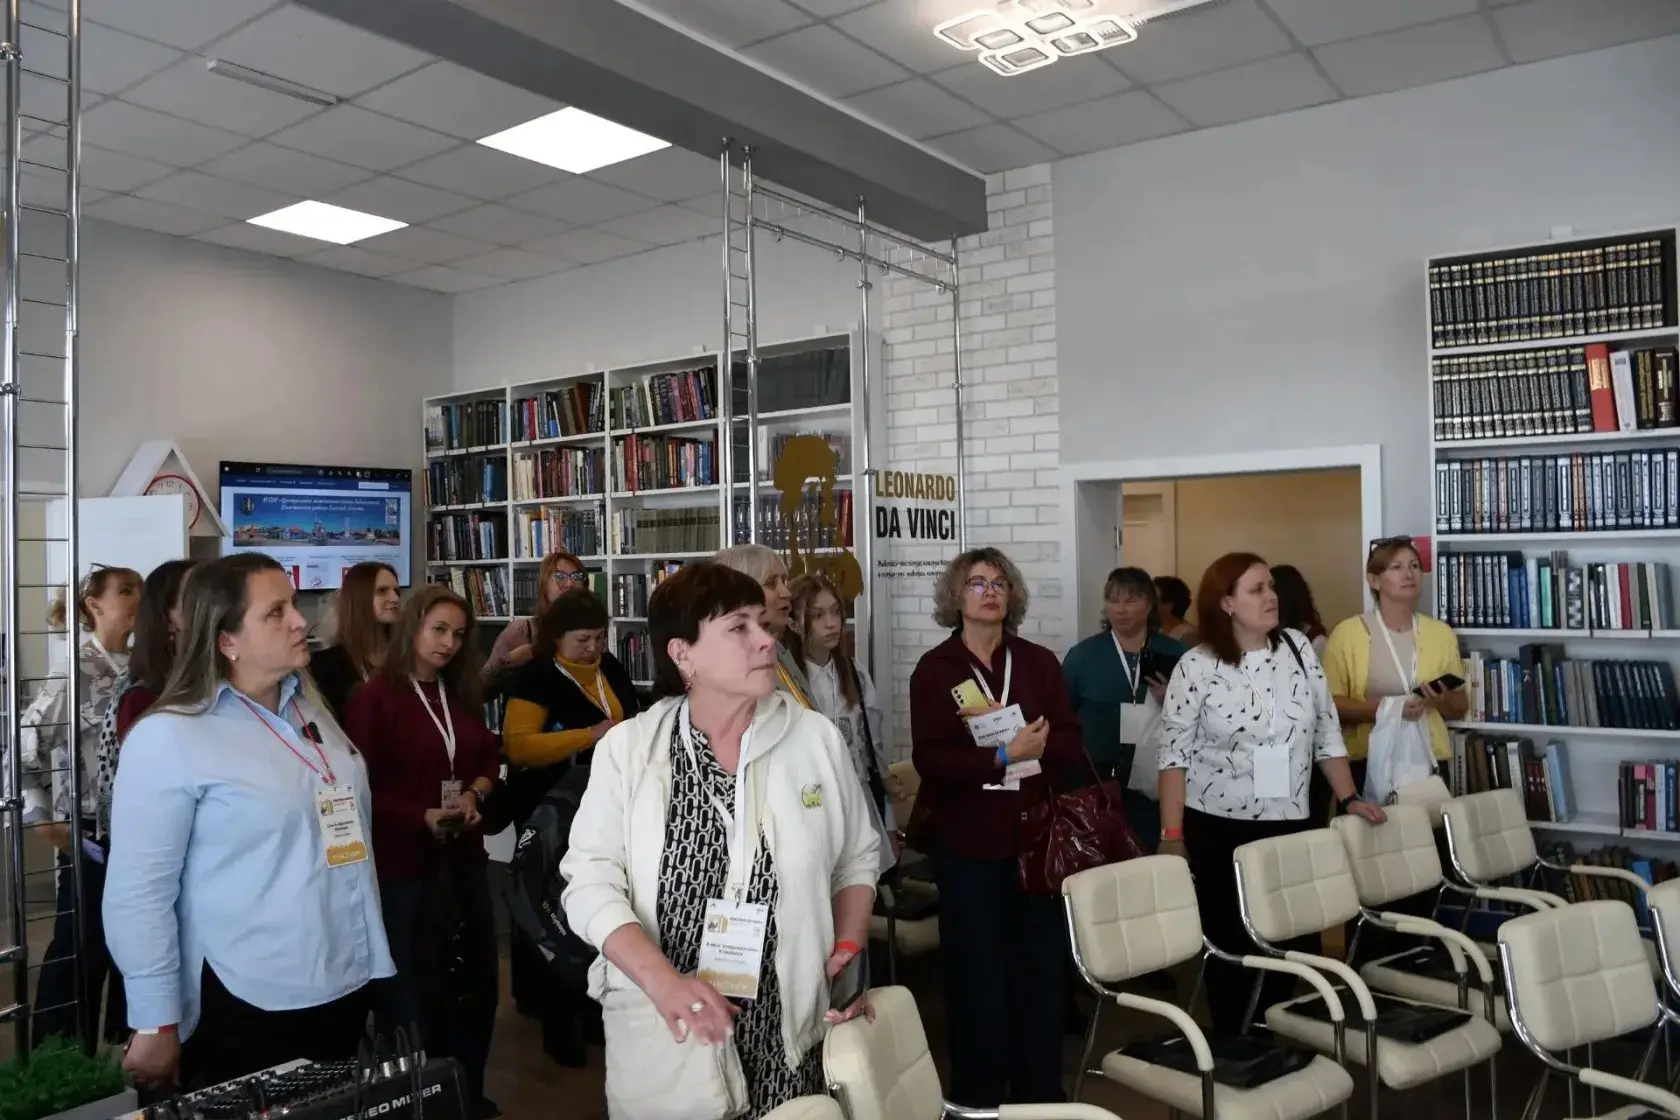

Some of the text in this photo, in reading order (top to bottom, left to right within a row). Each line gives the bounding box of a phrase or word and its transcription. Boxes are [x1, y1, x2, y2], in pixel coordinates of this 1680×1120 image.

[875, 469, 956, 502] LEONARDO
[875, 506, 956, 540] DA VINCI
